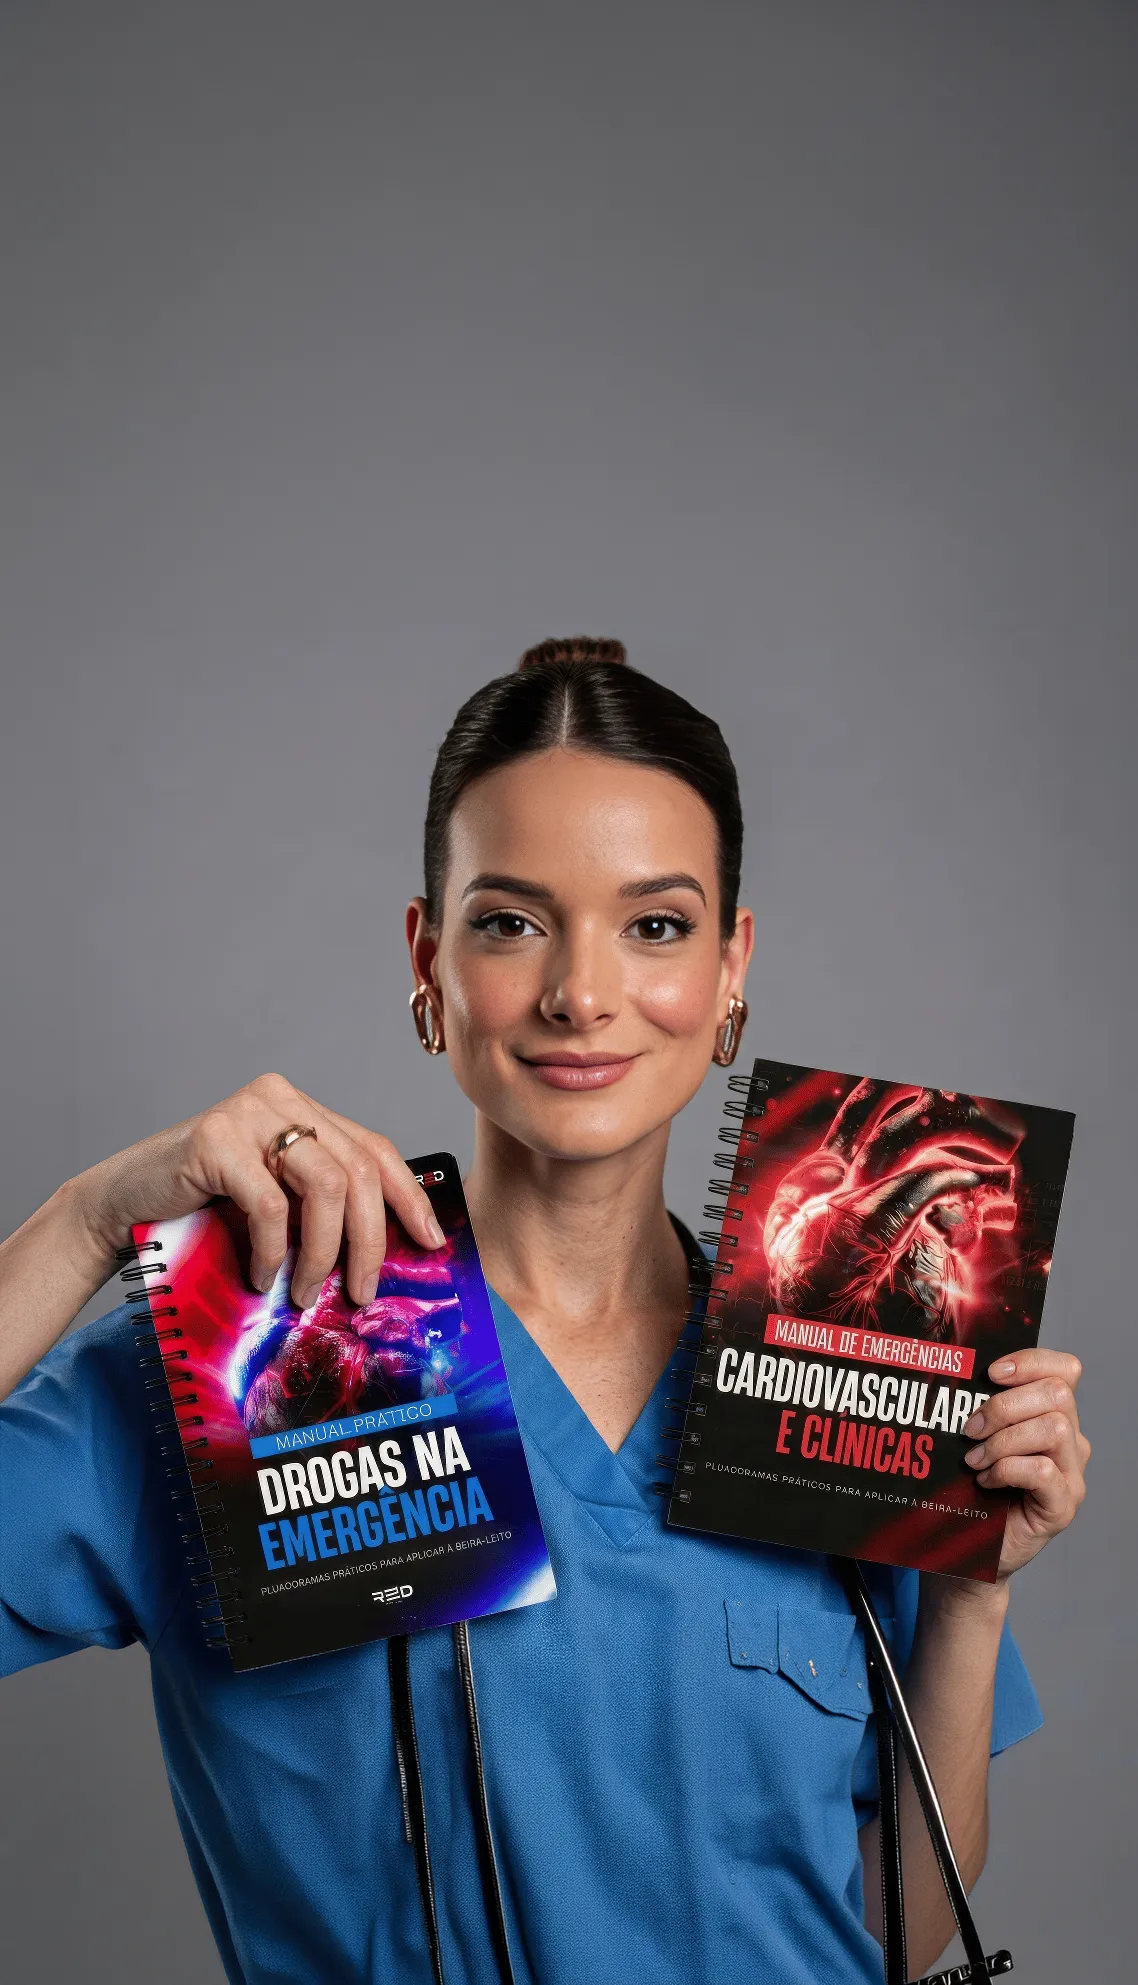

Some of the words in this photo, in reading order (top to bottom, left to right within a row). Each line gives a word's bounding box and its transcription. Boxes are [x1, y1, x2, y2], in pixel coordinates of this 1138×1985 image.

[775, 1319, 836, 1351] MANUAL
[839, 1331, 859, 1356] DE
[861, 1337, 963, 1373] EMERGÊNCIAS
[275, 1422, 352, 1450] MANUAL
[775, 1410, 797, 1455] E
[800, 1411, 934, 1480] CLÍNICAS
[257, 1439, 407, 1516] DROGAS
[412, 1426, 472, 1481] NA
[258, 1476, 494, 1571] EMERGÊNCIA
[835, 1485, 861, 1497] PARA
[864, 1490, 908, 1505] APLICAR
[921, 1500, 988, 1520] BEIRA-LEITO
[380, 1556, 405, 1569] PARA
[406, 1546, 445, 1563] APLICAR
[455, 1530, 512, 1551] BEIRA-LEITO
[371, 1584, 414, 1602] RED
